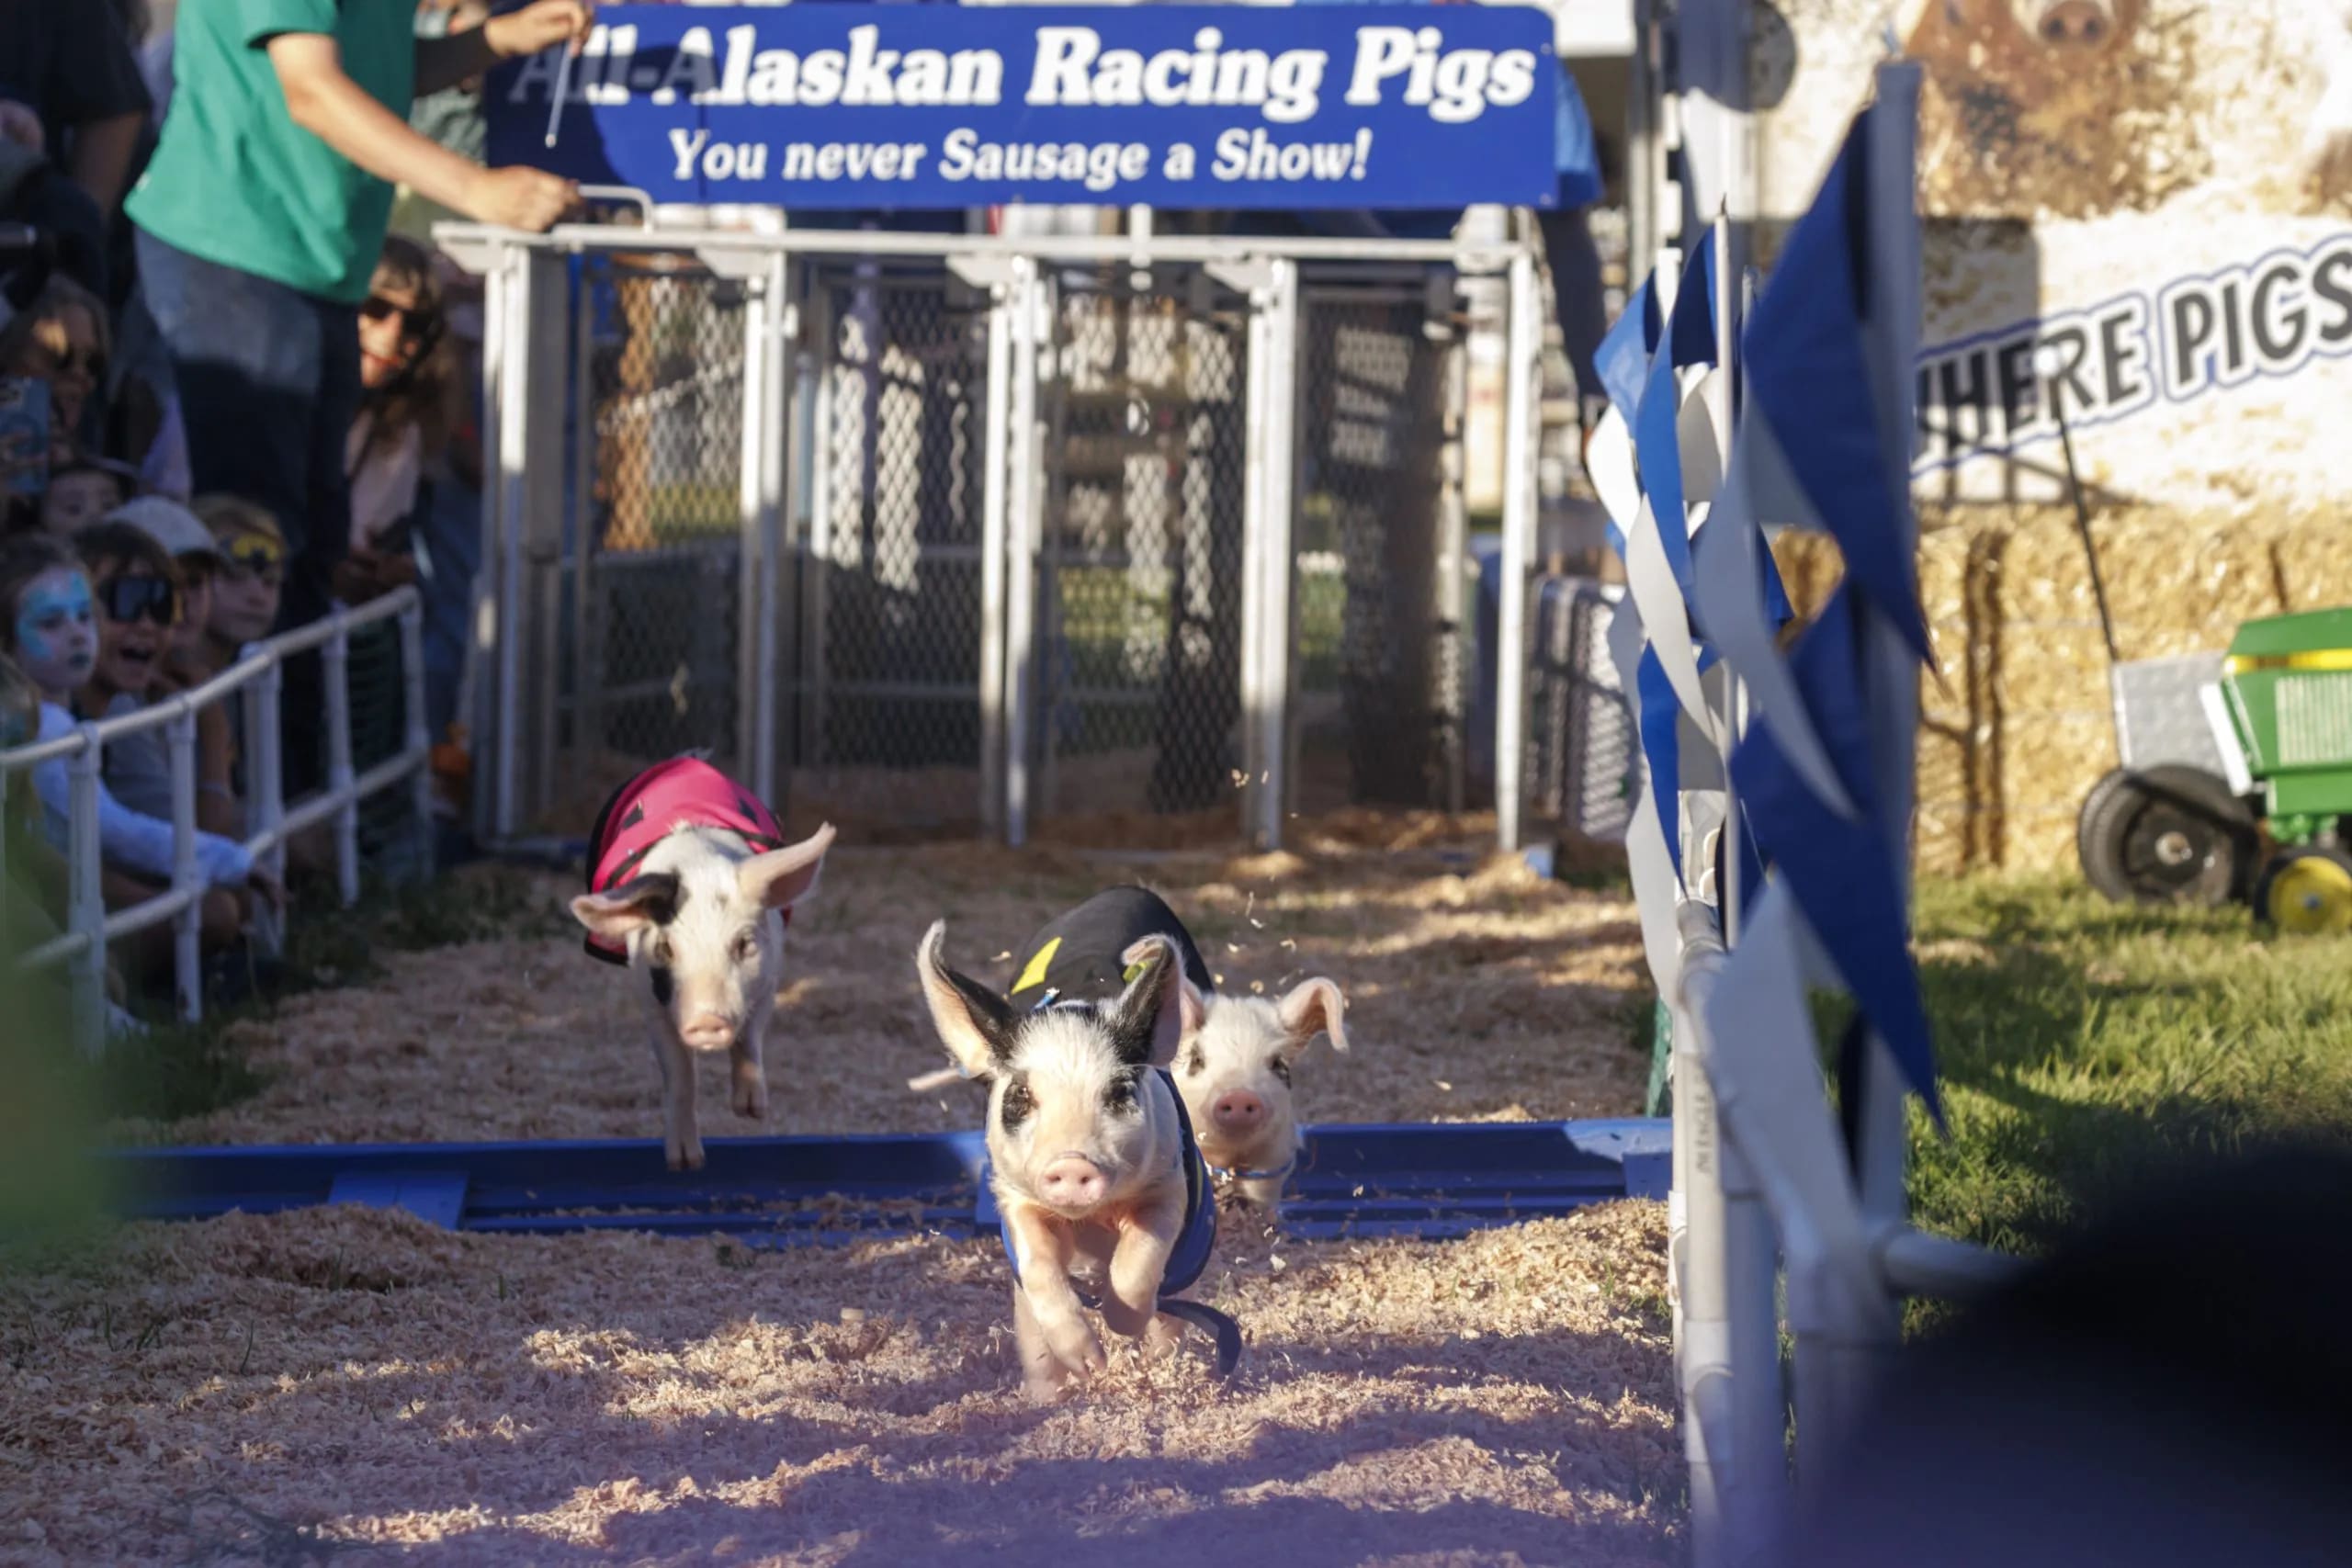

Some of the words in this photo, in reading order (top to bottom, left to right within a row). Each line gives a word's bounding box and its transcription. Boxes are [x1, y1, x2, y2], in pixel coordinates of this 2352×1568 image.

[1024, 26, 1329, 122] Racing
[1344, 26, 1537, 122] Pigs
[668, 128, 767, 181] You
[782, 141, 927, 181] never
[938, 127, 1150, 191] Sausage
[1162, 141, 1195, 181] a
[1210, 127, 1374, 181] Show!
[1917, 309, 2142, 450] HERE
[2172, 250, 2352, 388] PIGS
